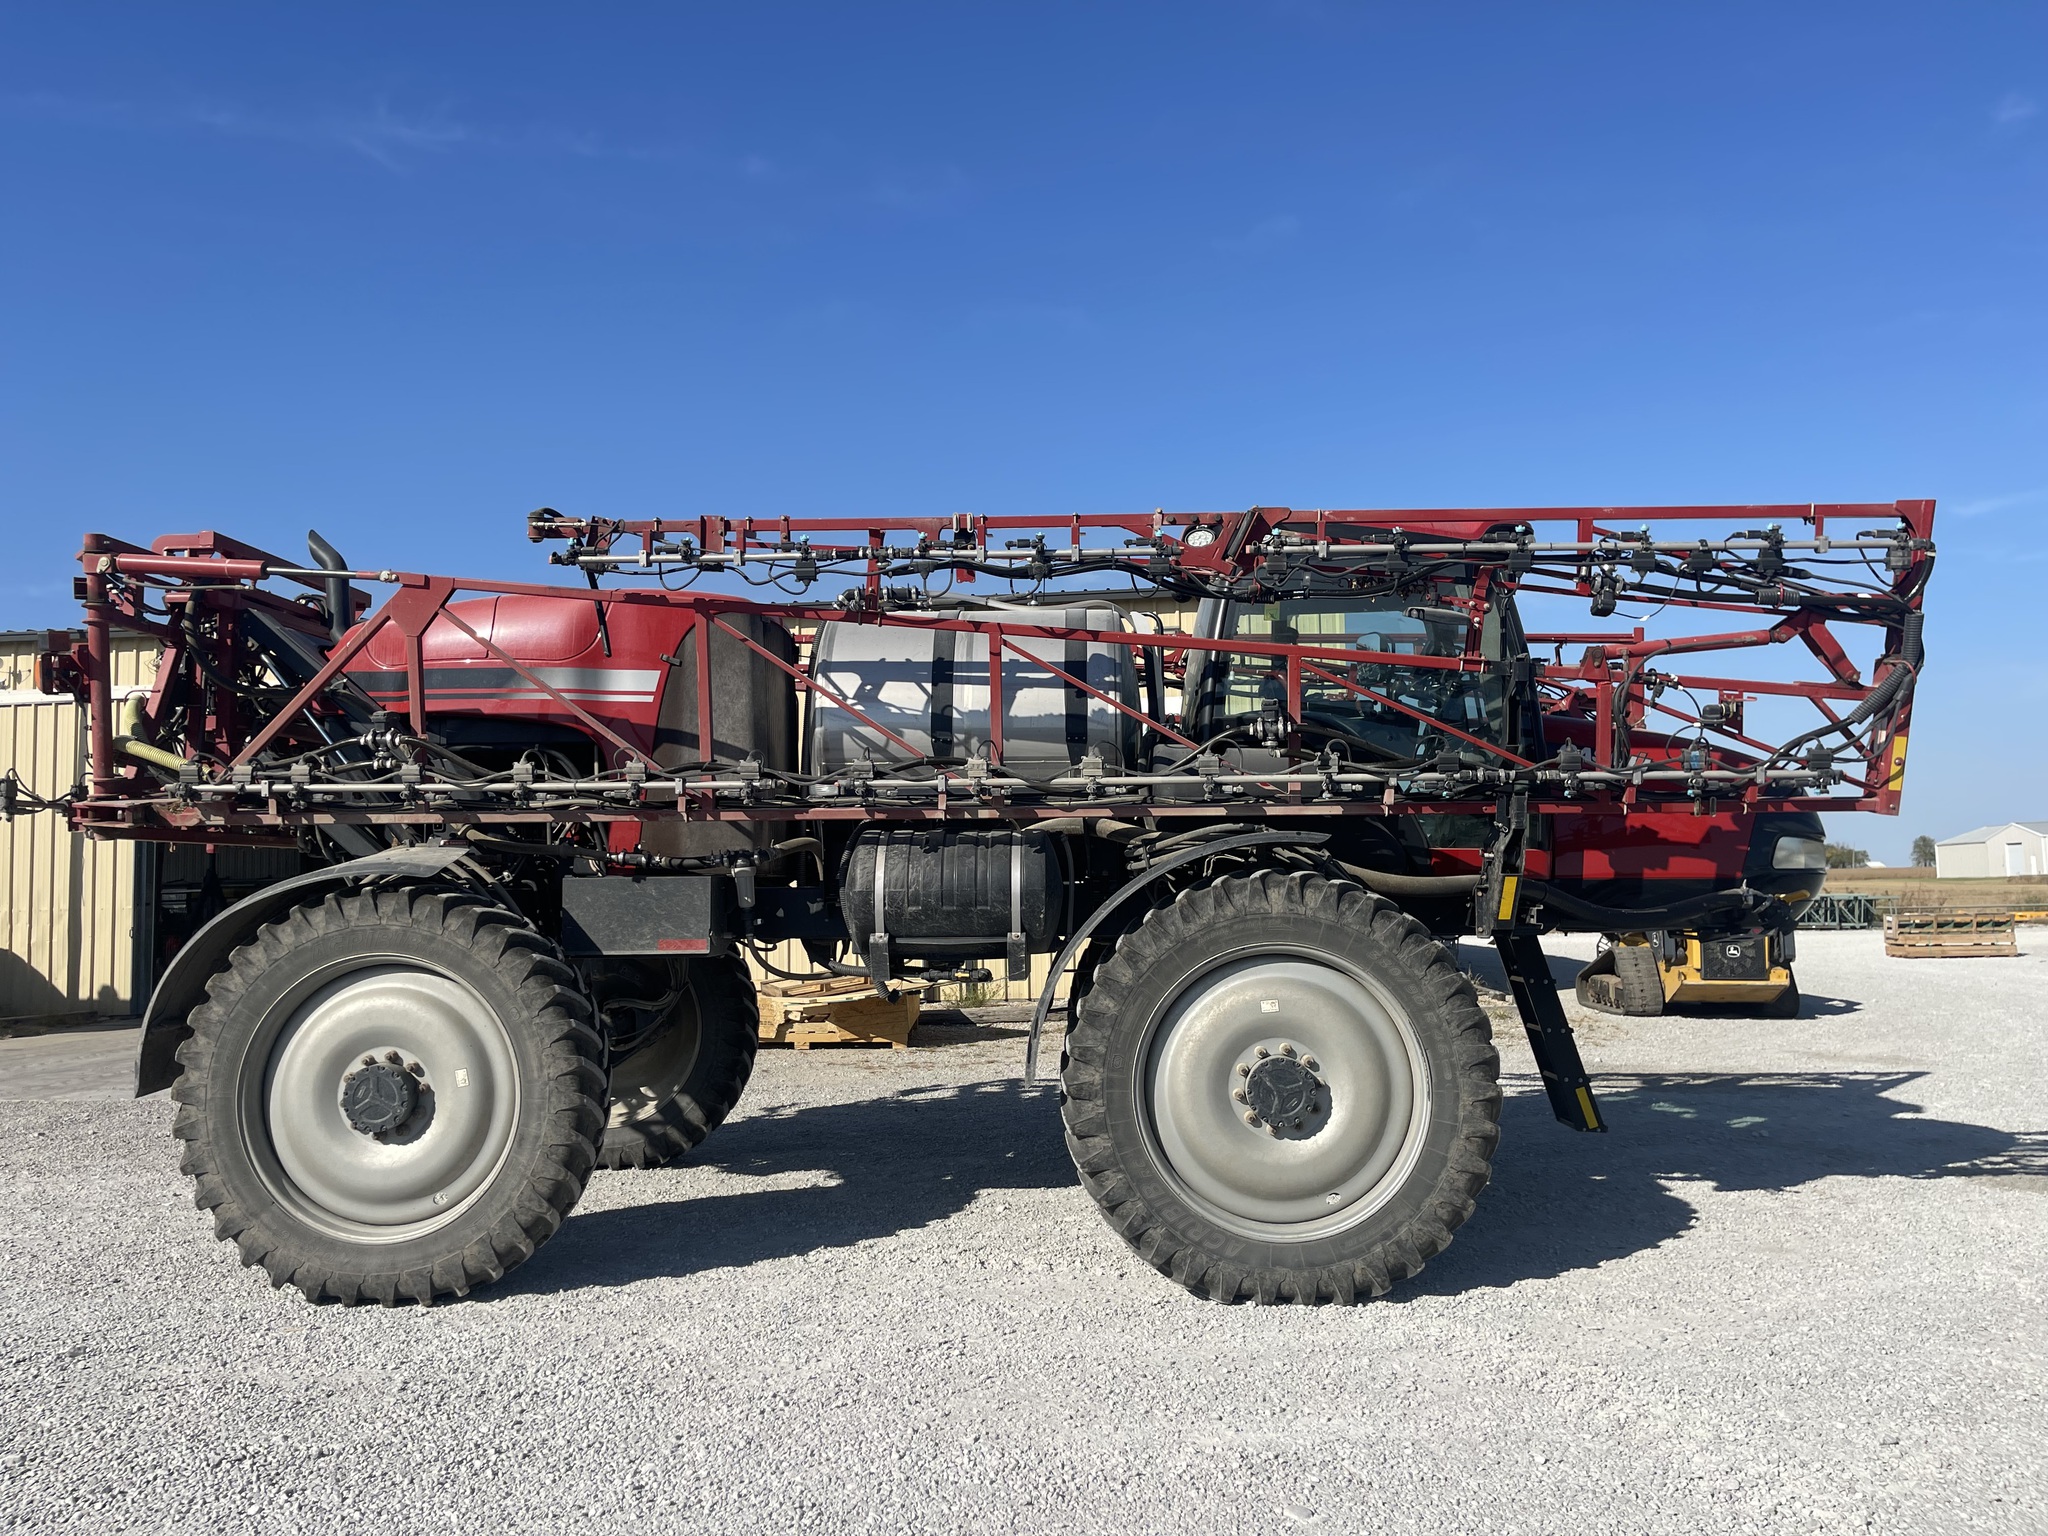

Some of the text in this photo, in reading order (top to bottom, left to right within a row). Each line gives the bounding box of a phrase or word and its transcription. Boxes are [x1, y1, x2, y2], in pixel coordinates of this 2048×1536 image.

[1368, 949, 1429, 1010] 380/90
[1422, 1009, 1438, 1026] R
[1432, 1027, 1450, 1056] 46
[1131, 1155, 1248, 1260] AGRIBIB RC
